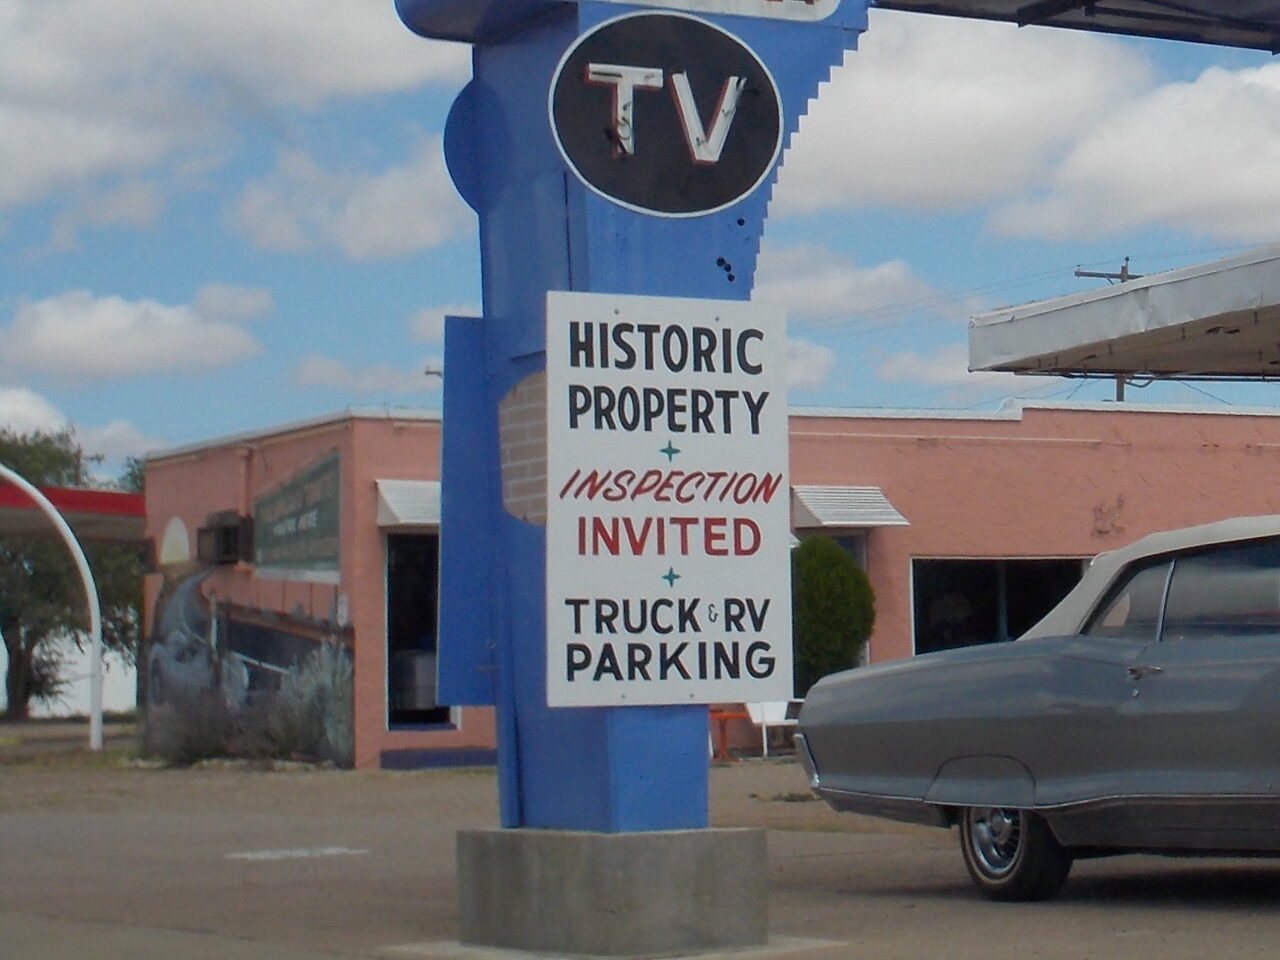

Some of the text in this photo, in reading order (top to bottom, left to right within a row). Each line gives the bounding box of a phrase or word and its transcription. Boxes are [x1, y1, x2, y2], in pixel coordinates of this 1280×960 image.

[584, 62, 747, 166] TV
[568, 320, 764, 375] HISTORIC
[568, 384, 770, 435] PROPERTY
[559, 469, 783, 505] INSPECTION
[577, 515, 762, 556] INVITED
[564, 597, 771, 635] TRUCK & RV
[566, 641, 776, 682] PARKING
